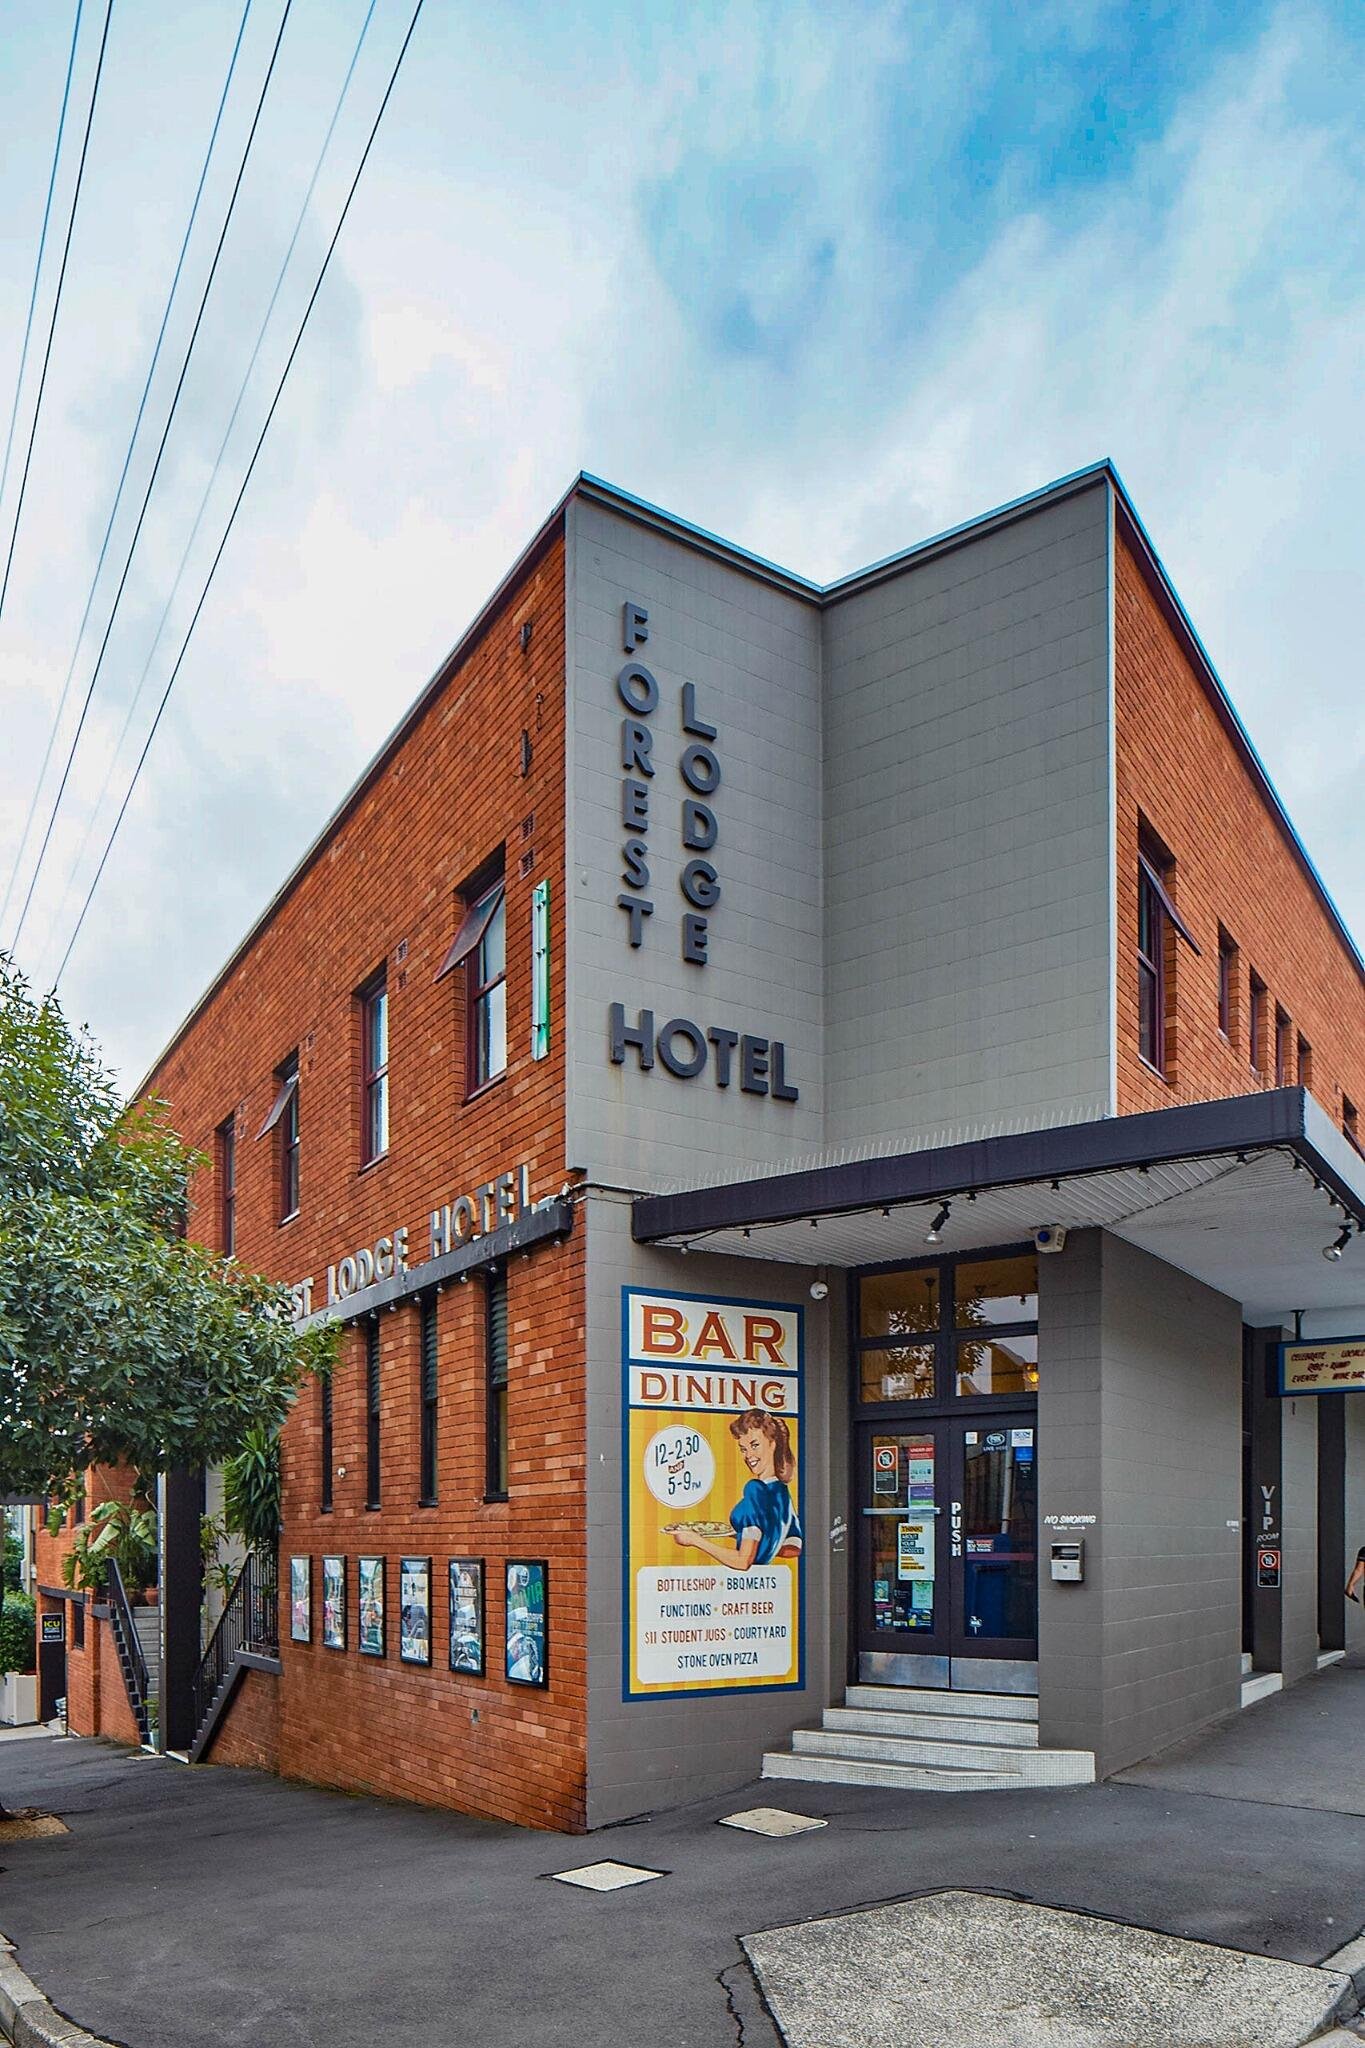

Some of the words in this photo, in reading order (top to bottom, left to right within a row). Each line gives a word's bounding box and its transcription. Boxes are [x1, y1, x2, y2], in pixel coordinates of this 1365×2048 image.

[617, 601, 659, 949] FOREST
[680, 681, 721, 966] LODGE
[609, 1002, 799, 1102] HOTEL
[327, 1226, 409, 1306] LODGE
[429, 1164, 537, 1259] HOTEL
[640, 1304, 789, 1367] BAR
[640, 1372, 786, 1410] DINING
[1044, 1515, 1058, 1524] NO
[1059, 1515, 1097, 1524] SMOKING
[1260, 1485, 1276, 1531] VIP
[951, 1502, 962, 1557] PUSH
[657, 1577, 717, 1592] BOTTLESHOP
[44, 1620, 60, 1628] ICU
[660, 1603, 712, 1618] FUNCTIONS
[722, 1602, 749, 1616] CRAFT
[751, 1601, 774, 1615] BEER
[661, 1629, 702, 1644] STUDENT
[704, 1627, 726, 1642] JUGS
[734, 1625, 787, 1641] COURTYARD
[677, 1654, 707, 1669] STONE
[709, 1652, 732, 1667] OVEN
[734, 1651, 759, 1665] PIZZA
